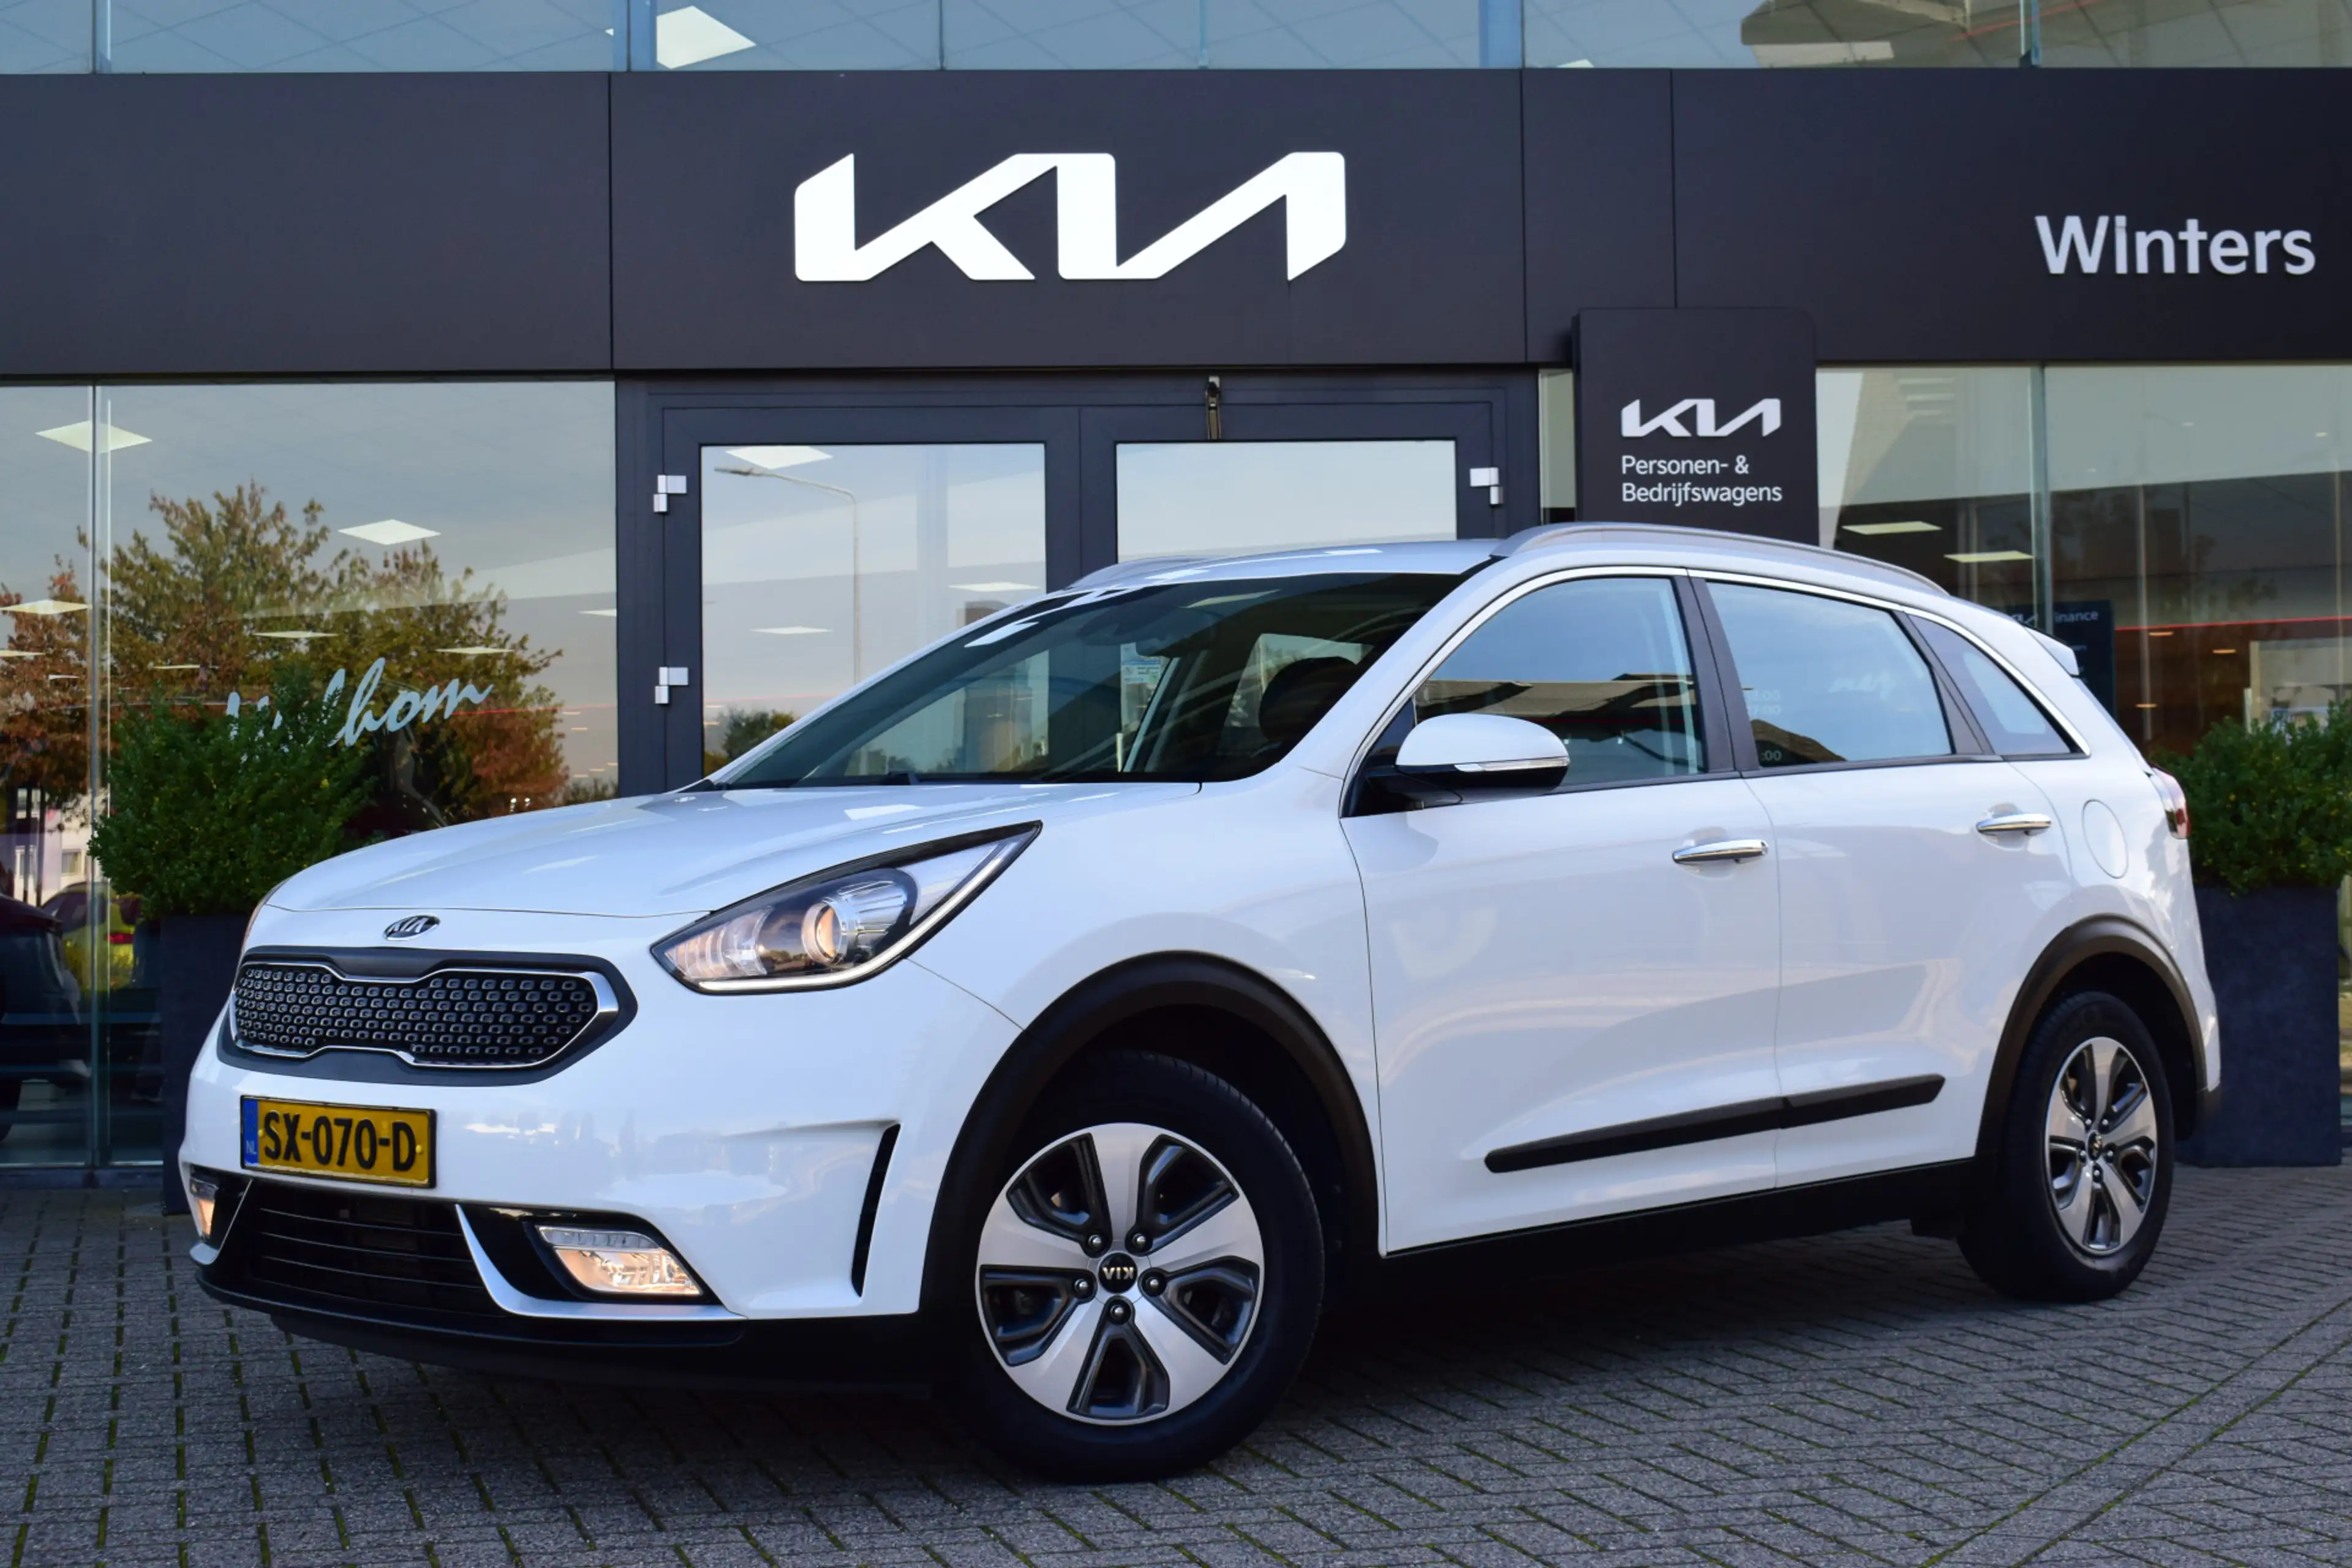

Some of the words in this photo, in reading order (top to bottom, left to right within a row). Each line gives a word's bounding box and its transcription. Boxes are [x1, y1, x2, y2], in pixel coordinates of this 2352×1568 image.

[794, 152, 1346, 281] KIA
[2035, 215, 2316, 275] Winters
[1621, 398, 1781, 437] KIA
[1622, 455, 1728, 475] Personen-
[1735, 454, 1749, 474] &
[1622, 482, 1782, 507] Bedrijfswagens
[2054, 611, 2099, 623] inance
[385, 916, 430, 935] KIA
[246, 1139, 257, 1155] NL
[263, 1110, 417, 1172] SX-070-D
